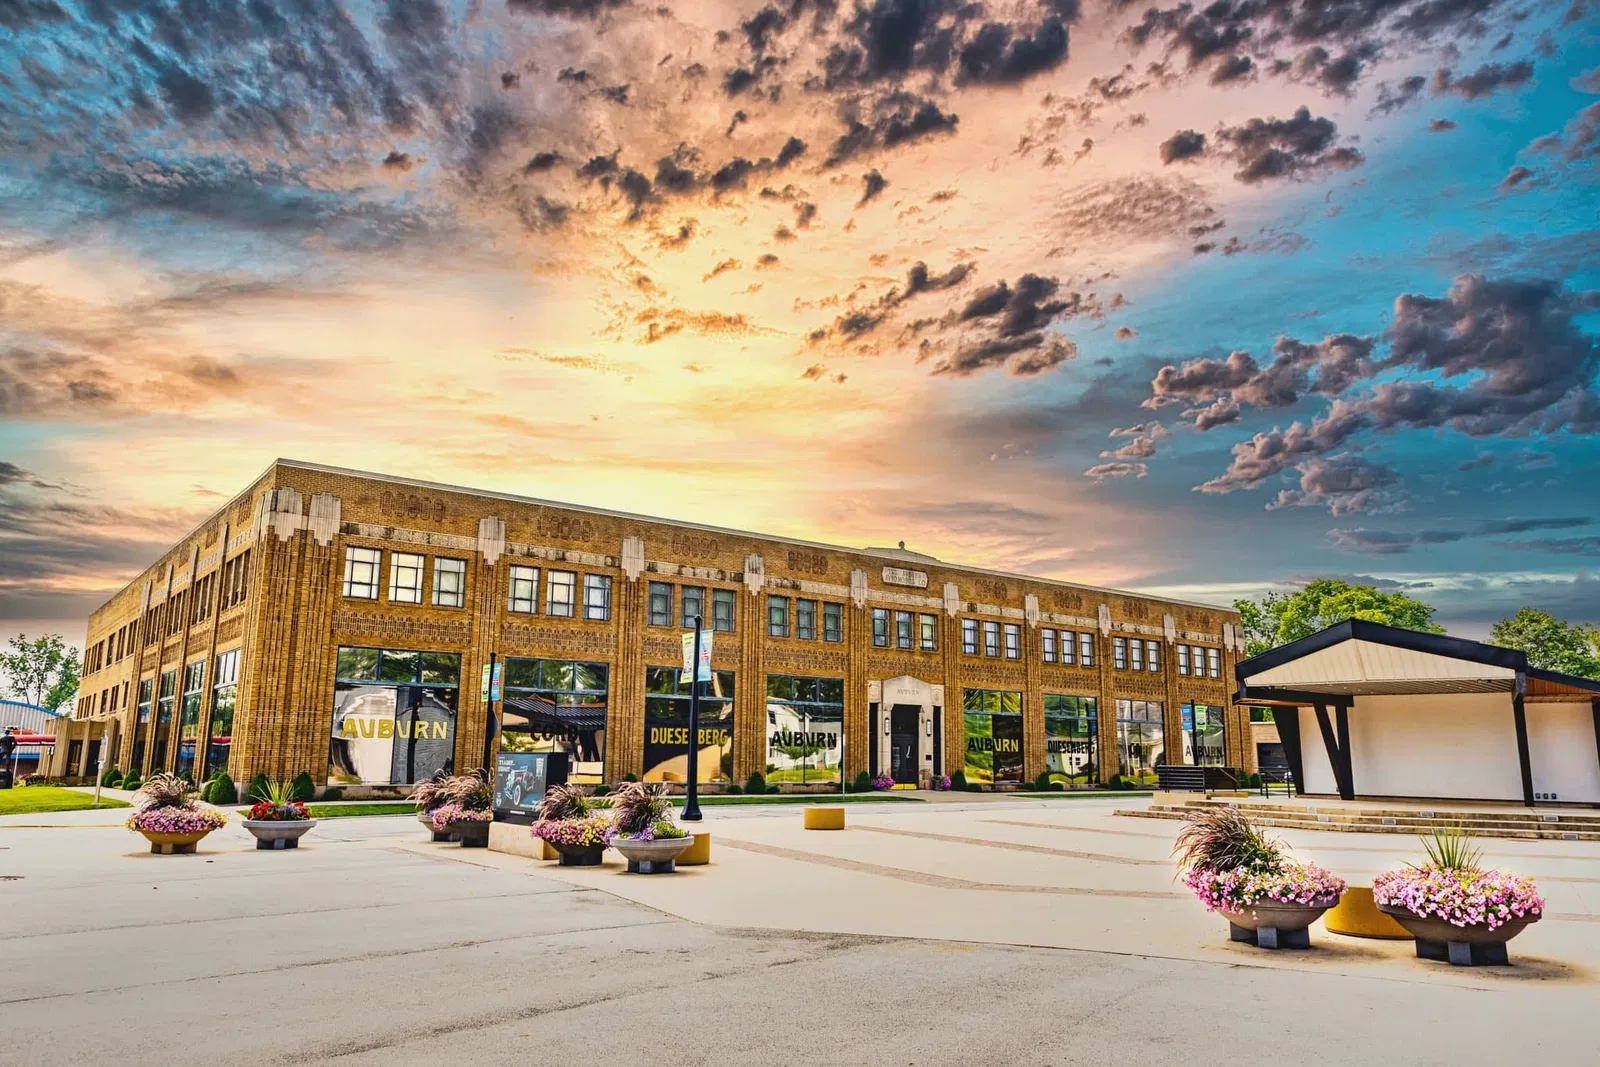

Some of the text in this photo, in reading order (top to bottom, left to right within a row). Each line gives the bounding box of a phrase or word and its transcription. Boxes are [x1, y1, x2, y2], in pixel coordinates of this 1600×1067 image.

[341, 718, 448, 740] AUBURN
[651, 727, 729, 745] DUESEBERG
[770, 731, 837, 748] AUBURN
[967, 737, 1019, 752] AUBURN
[1185, 745, 1224, 758] ABURN
